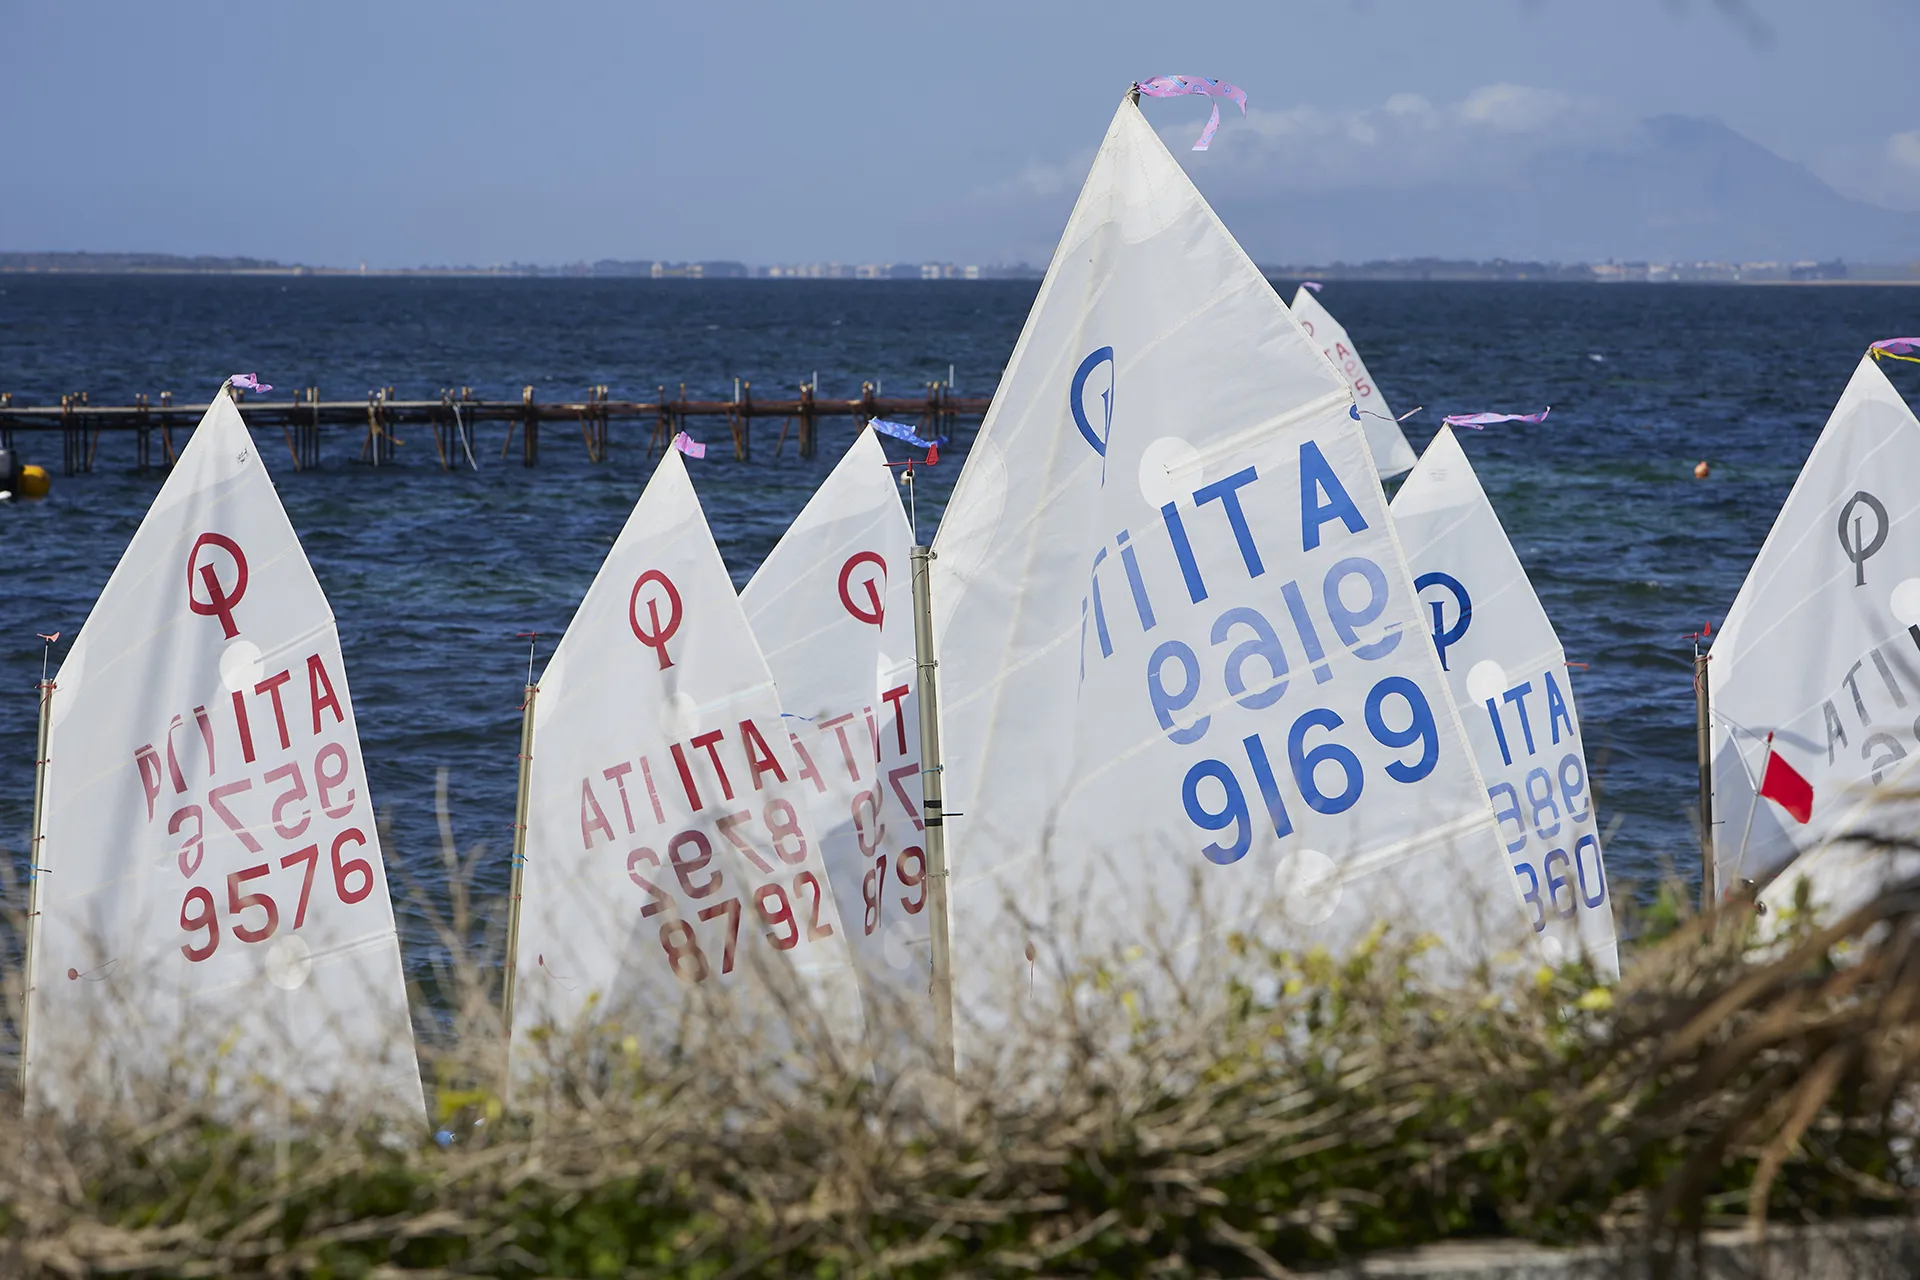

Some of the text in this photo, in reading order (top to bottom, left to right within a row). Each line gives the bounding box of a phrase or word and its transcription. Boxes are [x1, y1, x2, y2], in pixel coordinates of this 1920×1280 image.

[1161, 439, 1369, 604] ITA
[231, 653, 344, 764] ITA
[670, 718, 788, 812] ITA
[1486, 671, 1574, 766] ITA
[1182, 676, 1439, 865] 9169
[180, 827, 374, 963] 9576
[659, 870, 834, 984] 8792
